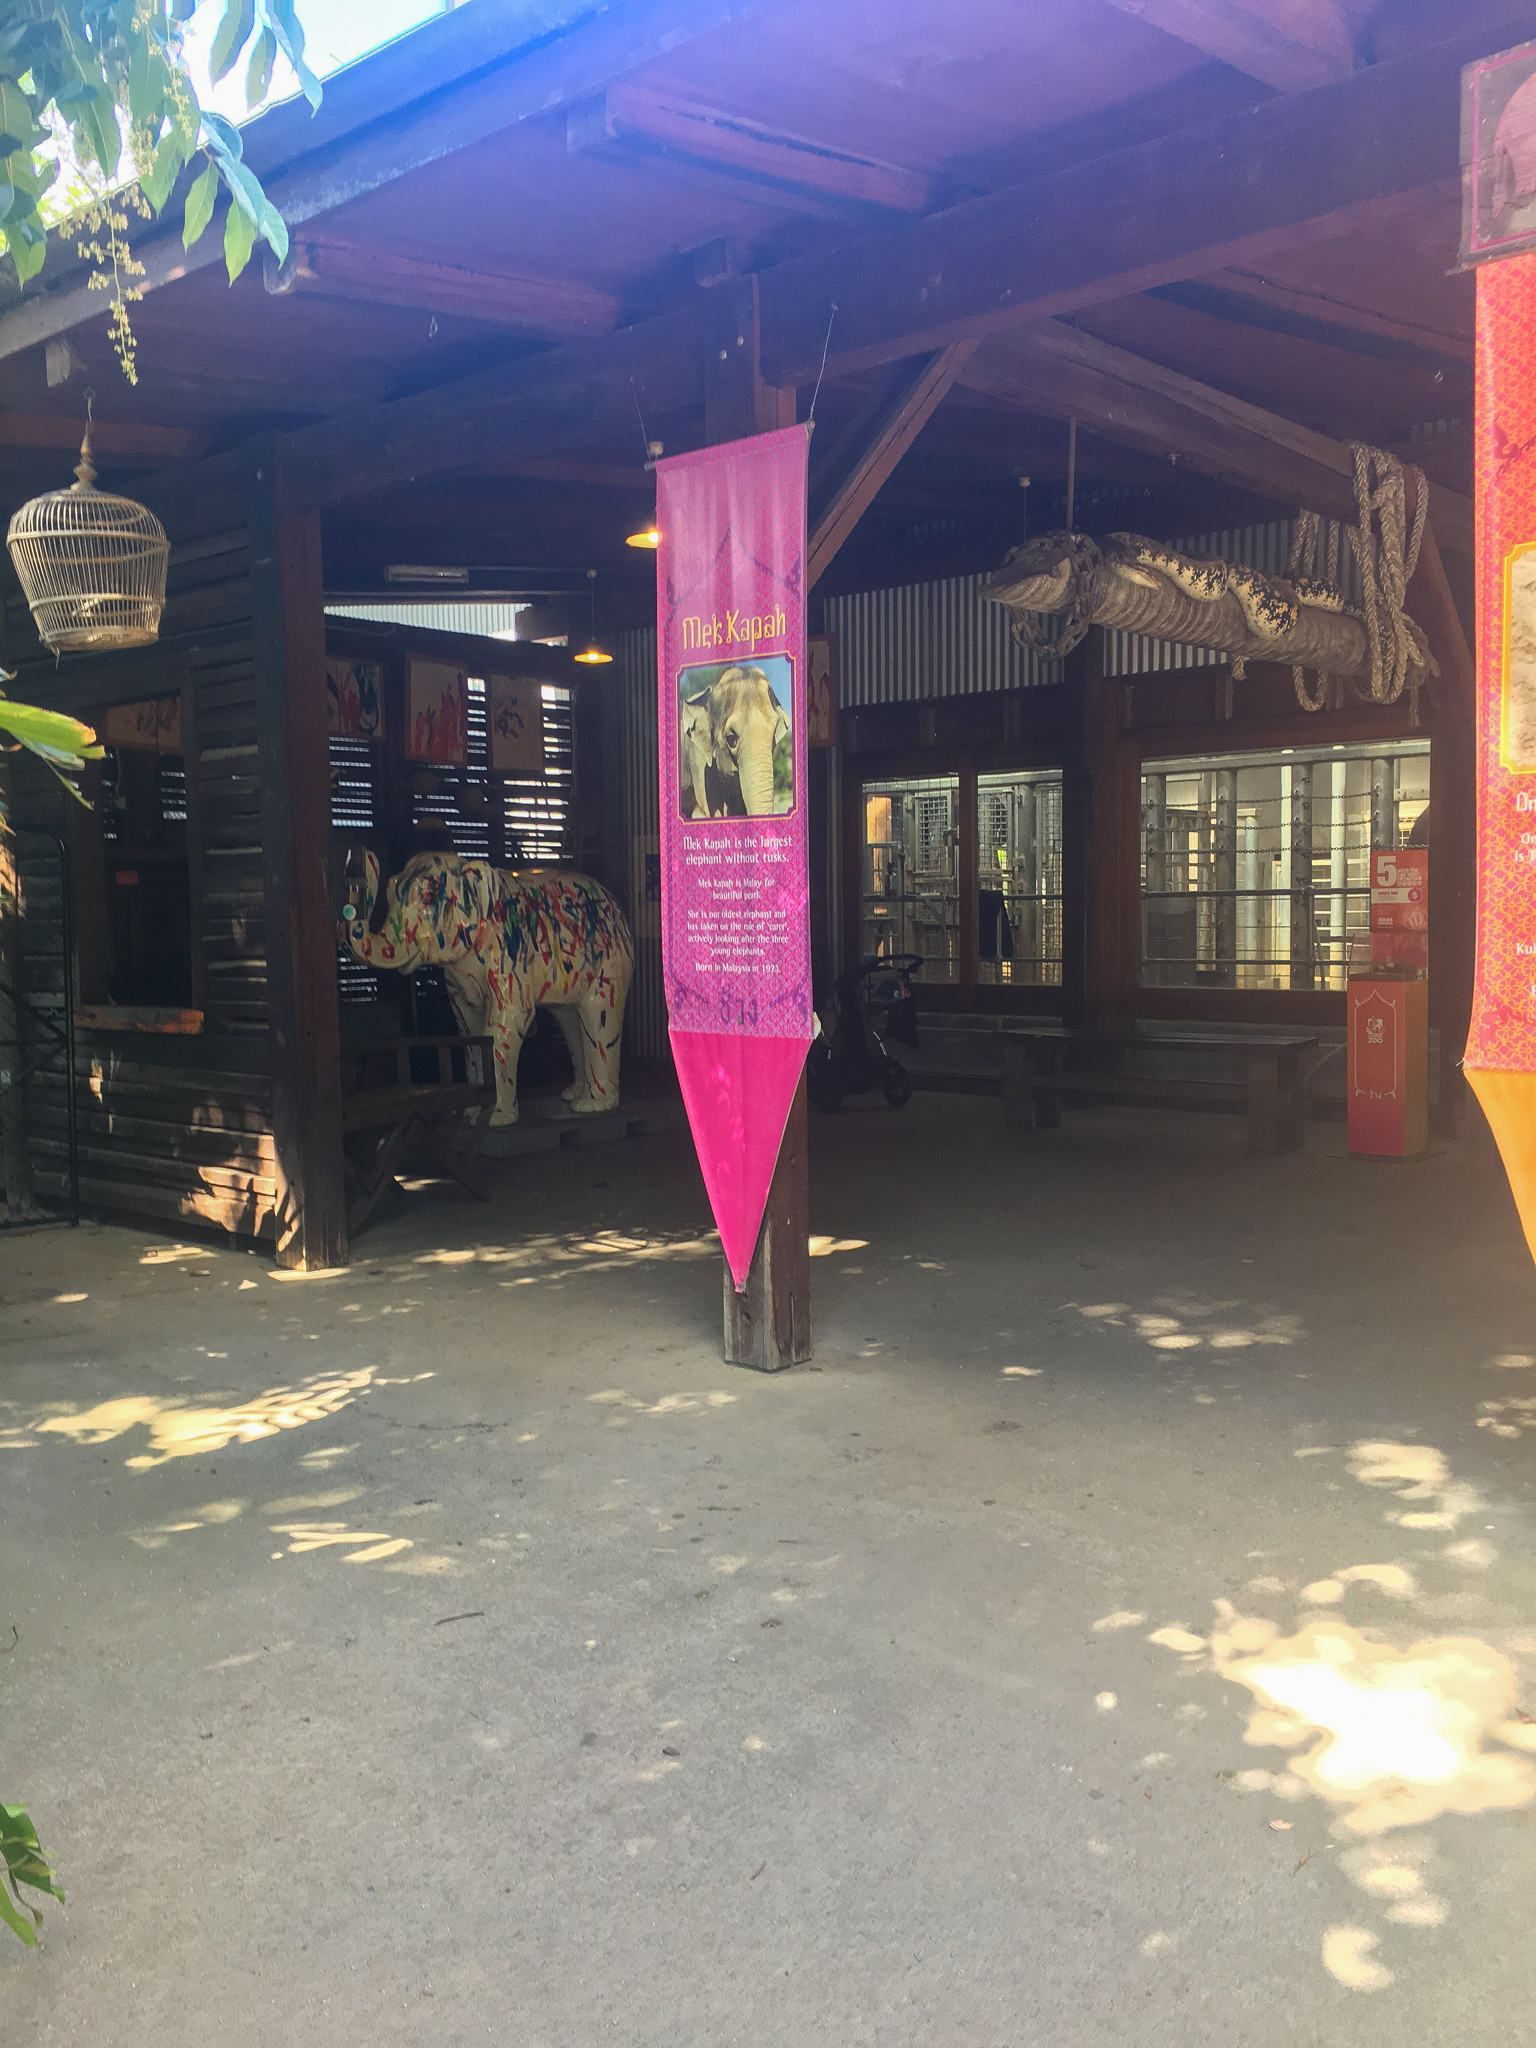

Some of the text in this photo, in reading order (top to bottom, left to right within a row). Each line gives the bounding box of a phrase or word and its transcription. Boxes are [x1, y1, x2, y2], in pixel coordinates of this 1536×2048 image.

[682, 604, 786, 652] Mek Kapah
[683, 835, 792, 851] Mek Kapah is the largest
[686, 850, 789, 867] elephant without tusks.
[1514, 850, 1525, 861] is
[1377, 855, 1396, 887] 5
[698, 877, 775, 889] Mek Kapah is Malay for
[713, 890, 743, 900] beautiful
[688, 909, 786, 920] She is our oldest elephant and
[687, 921, 698, 931] has
[700, 921, 719, 931] taken
[720, 923, 728, 931] on
[730, 921, 742, 931] the
[744, 921, 755, 931] role
[757, 920, 766, 931] of
[688, 933, 789, 945] actively looking after the three
[711, 946, 766, 957] young elephants.
[695, 962, 713, 972] Born
[714, 962, 721, 971] in
[722, 962, 751, 974] Malaysia
[752, 963, 759, 972] in
